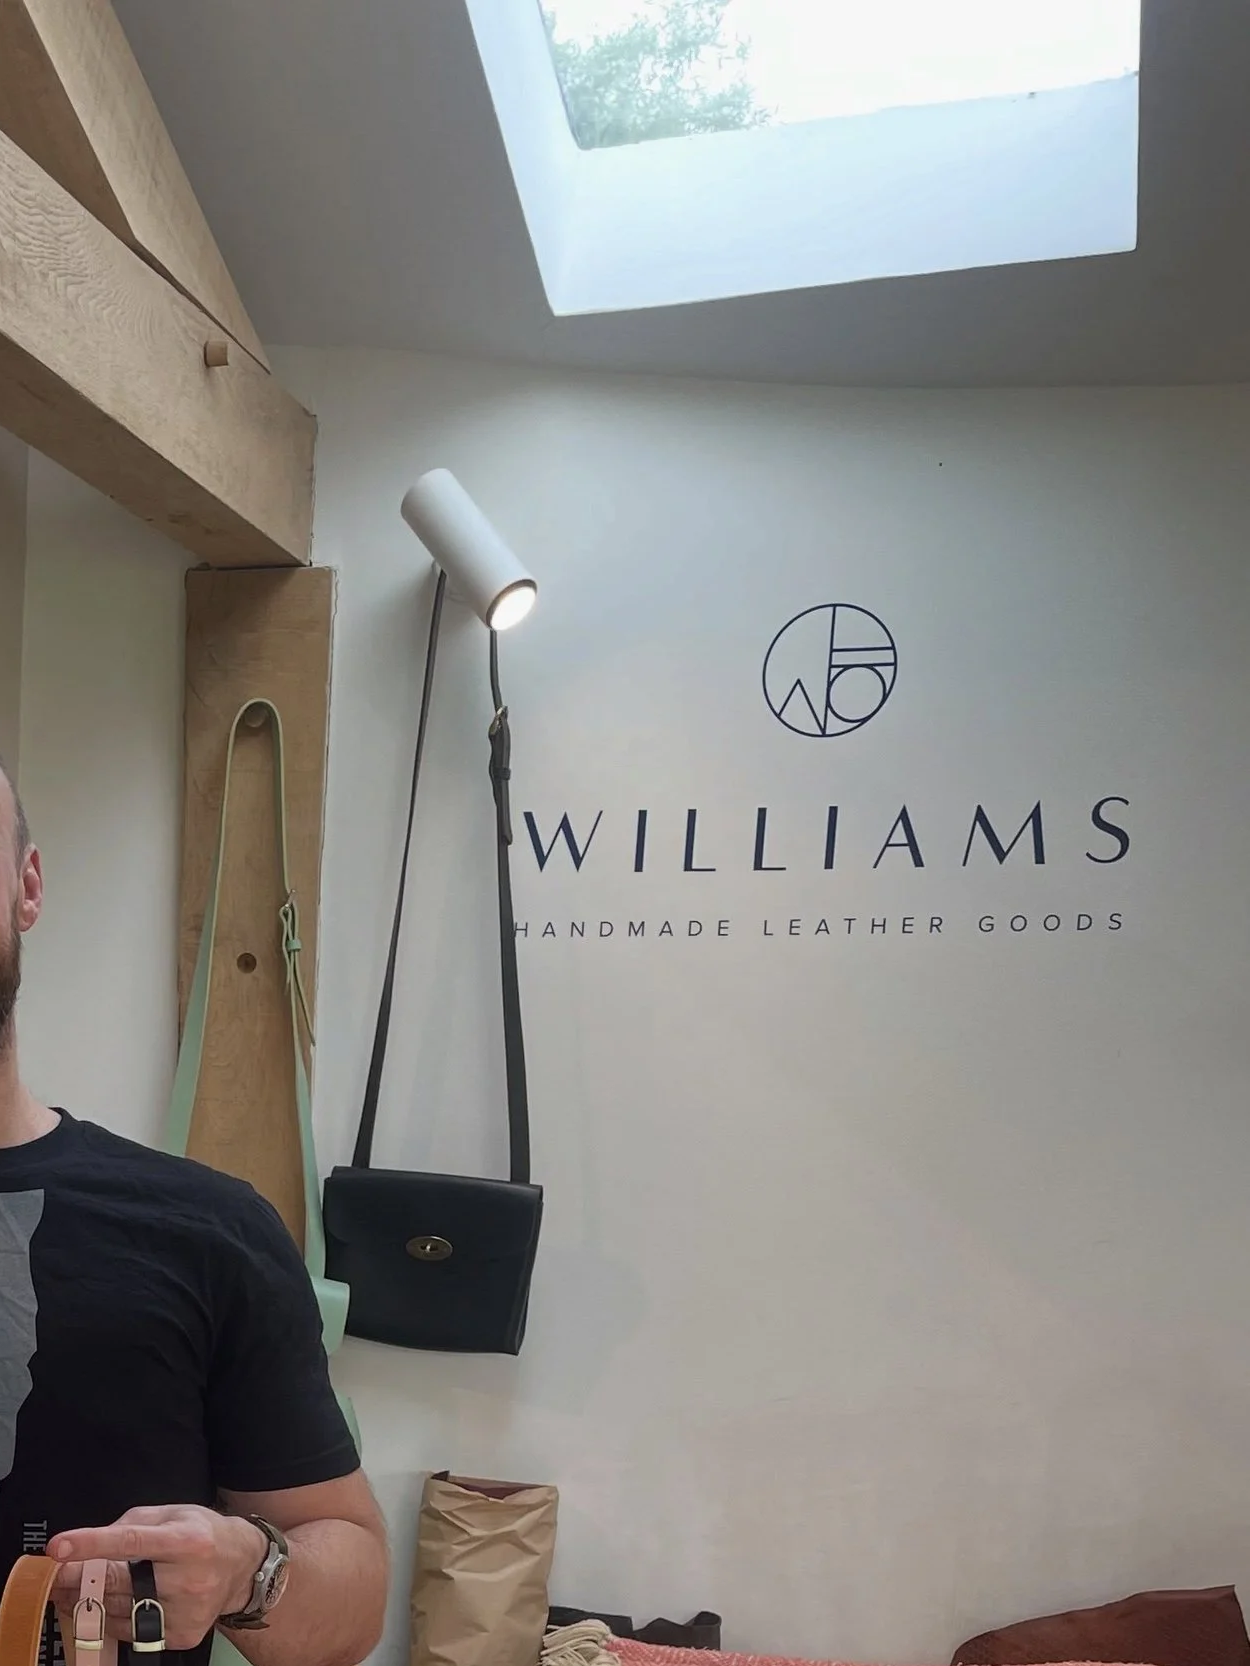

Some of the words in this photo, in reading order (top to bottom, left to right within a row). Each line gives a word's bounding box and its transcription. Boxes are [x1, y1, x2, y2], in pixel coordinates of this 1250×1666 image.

[522, 796, 1131, 873] WILLIAMS
[513, 919, 731, 938] HANDMADE
[762, 916, 944, 936] LEATHER
[978, 912, 1123, 933] GOODS
